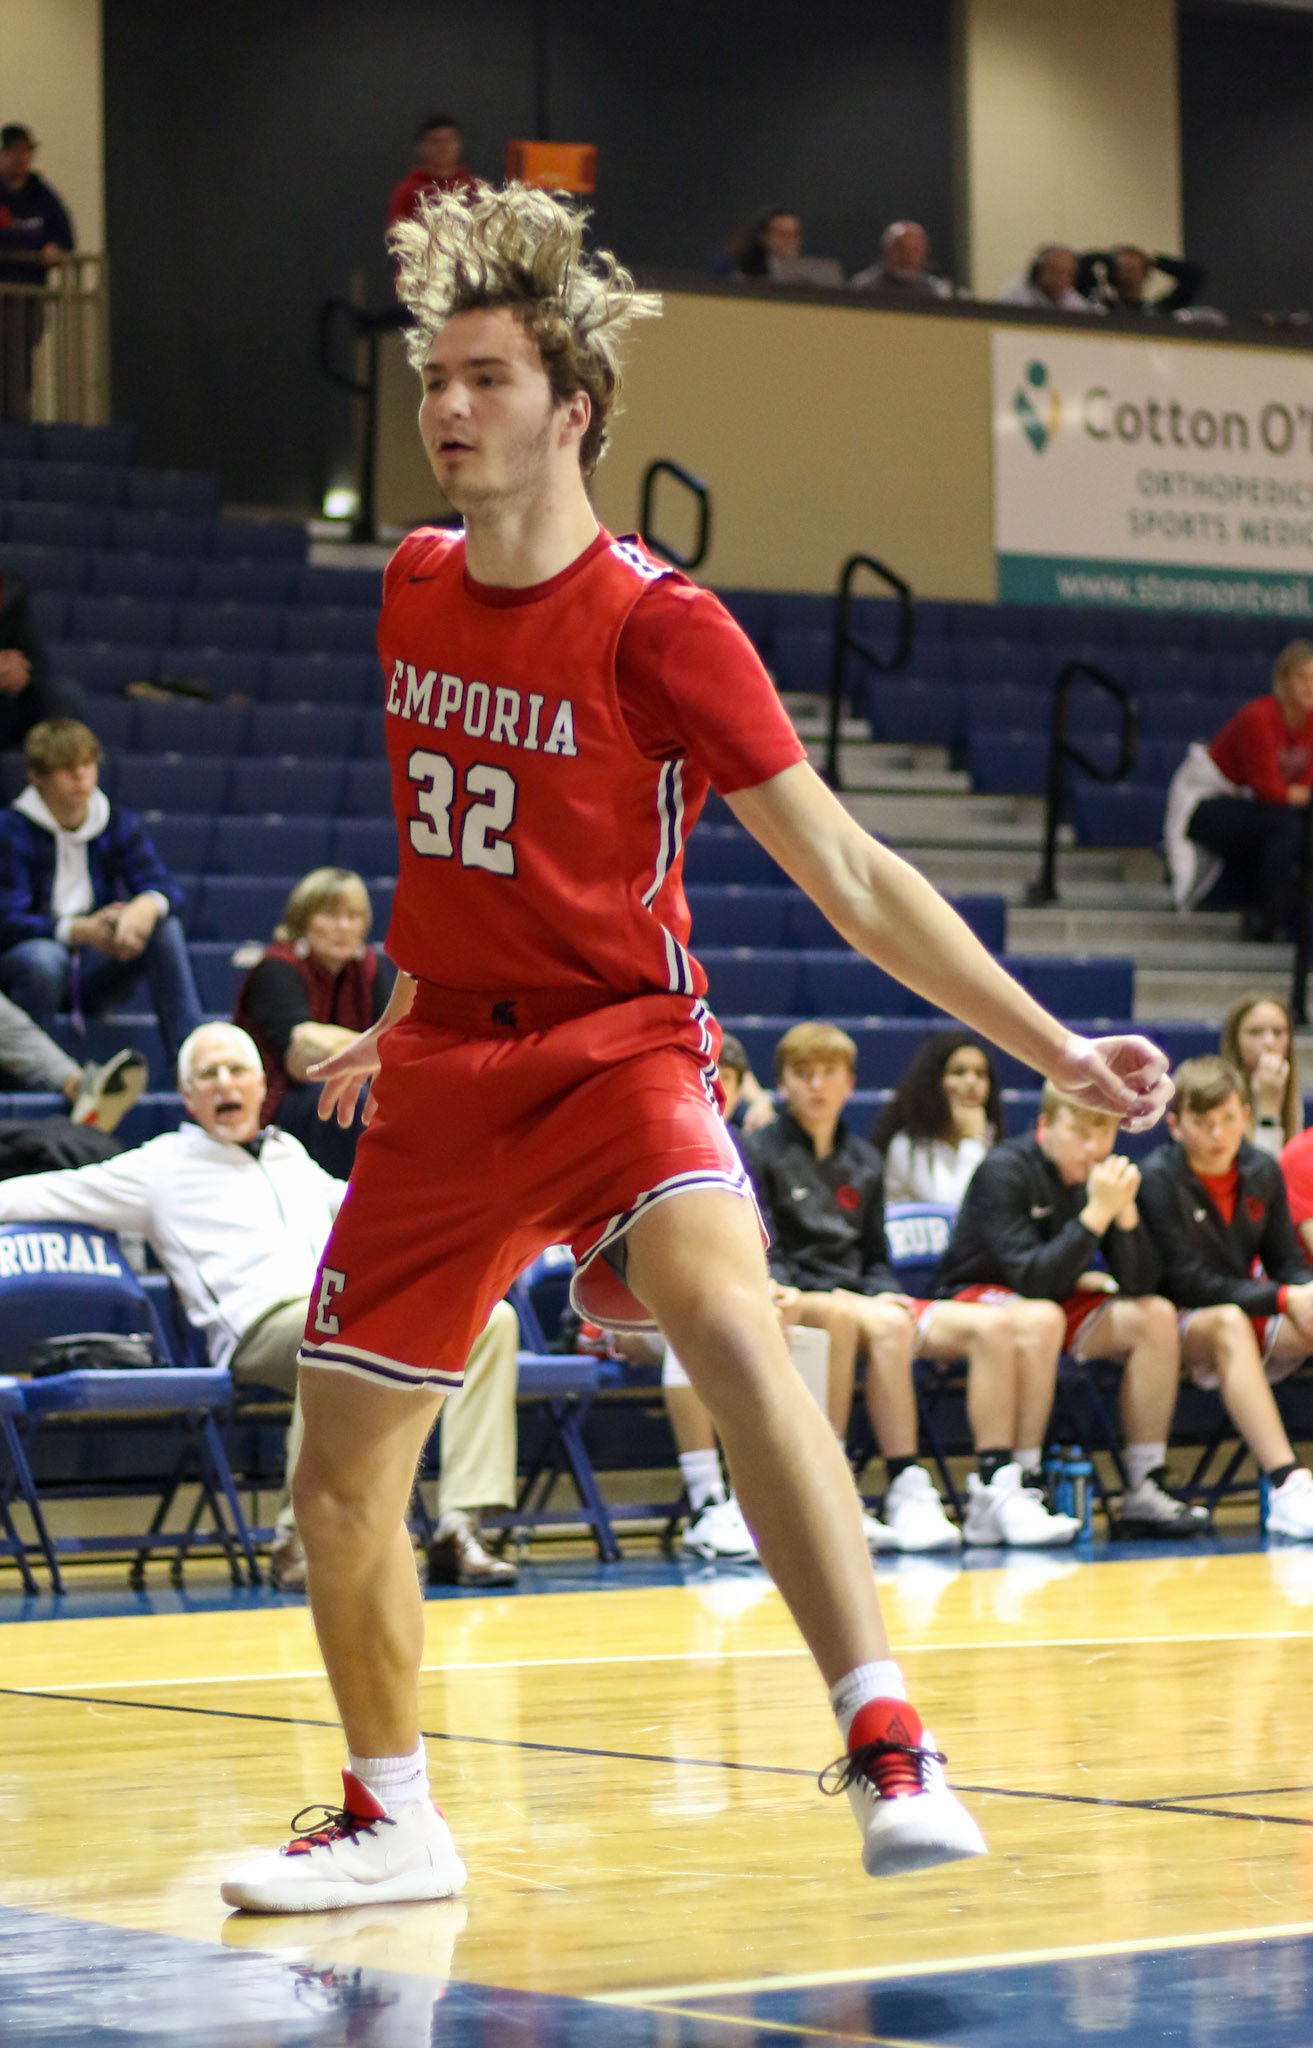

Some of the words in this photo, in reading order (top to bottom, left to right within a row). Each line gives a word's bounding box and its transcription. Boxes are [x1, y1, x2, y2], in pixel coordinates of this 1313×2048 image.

[1084, 386, 1249, 450] Cotton
[1259, 402, 1313, 456] O'
[1126, 507, 1228, 543] SPORTS
[386, 658, 579, 757] EMPORIA
[407, 746, 517, 879] 32
[0, 1232, 122, 1277] RURAL
[313, 1266, 347, 1336] E
